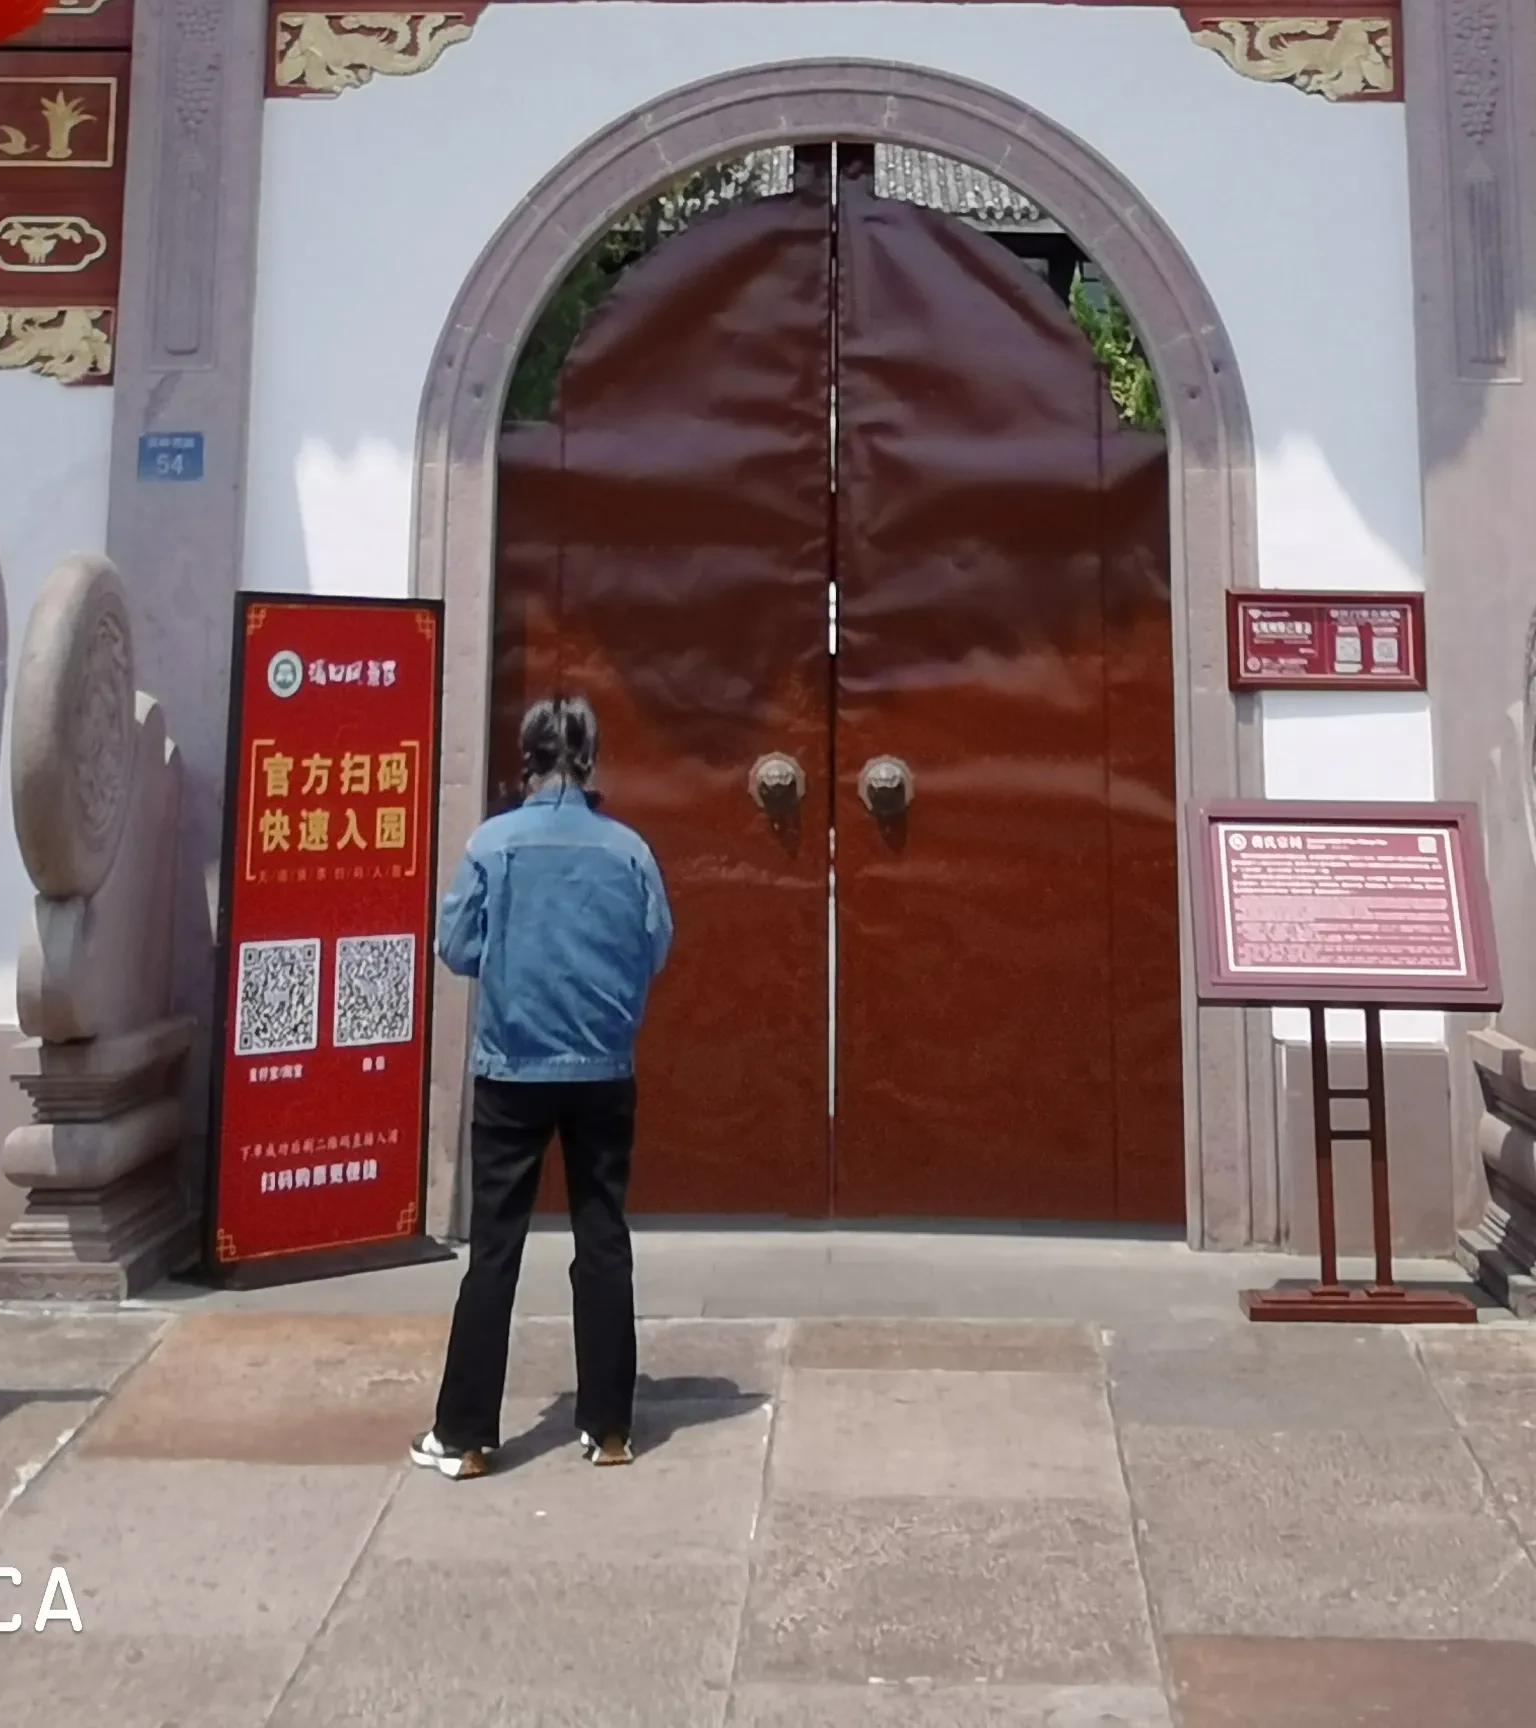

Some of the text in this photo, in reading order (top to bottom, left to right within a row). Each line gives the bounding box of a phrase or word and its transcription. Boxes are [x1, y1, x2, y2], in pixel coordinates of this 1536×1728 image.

[262, 751, 409, 798] 官方扫码
[258, 806, 407, 854] 快速入园
